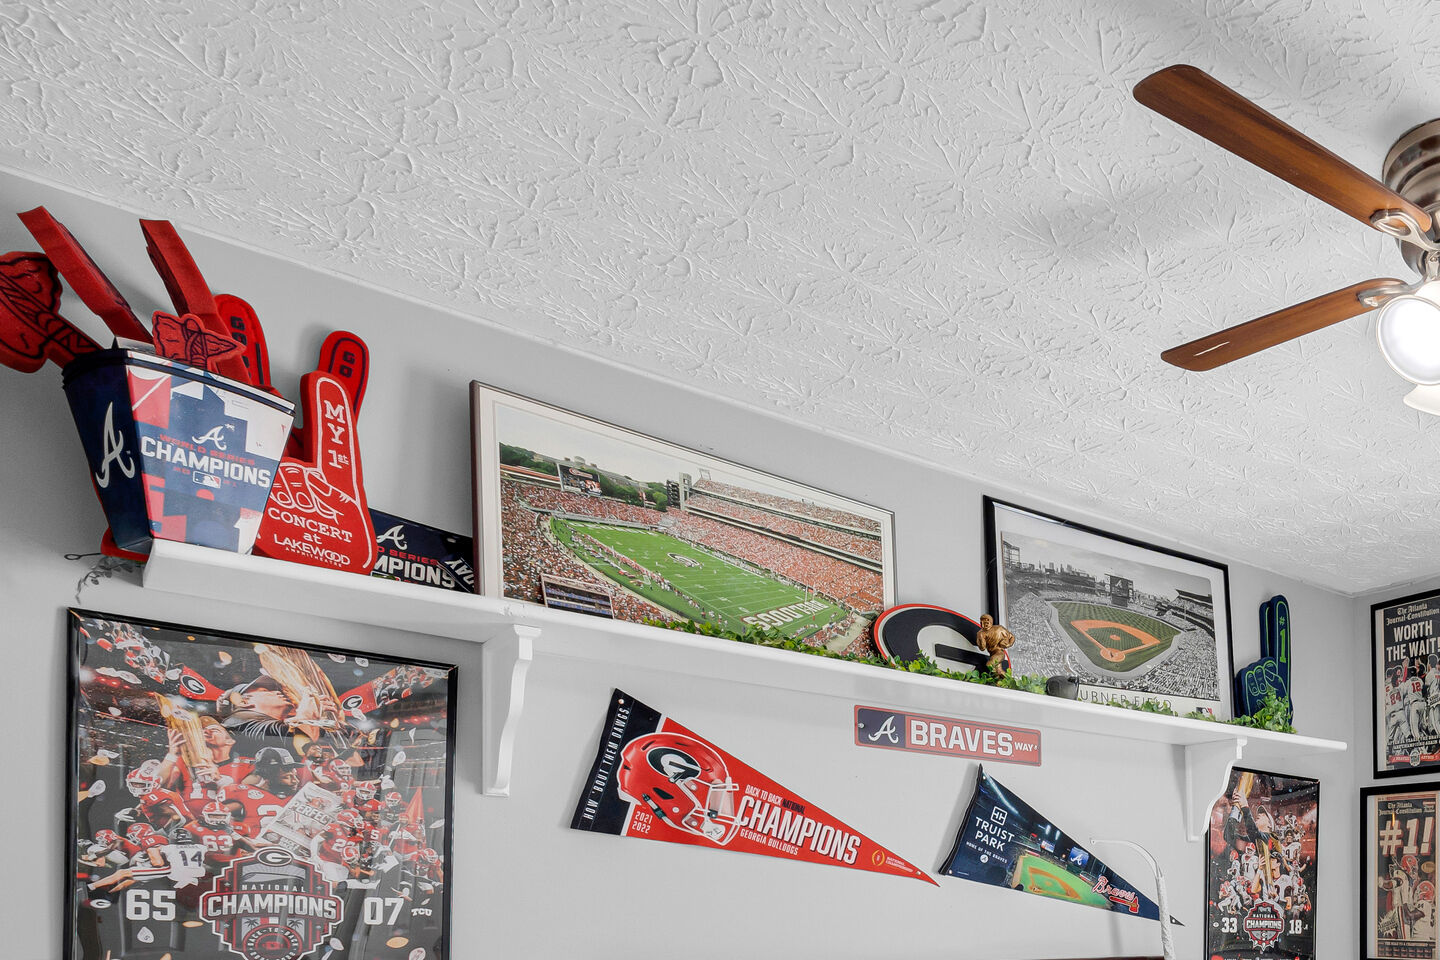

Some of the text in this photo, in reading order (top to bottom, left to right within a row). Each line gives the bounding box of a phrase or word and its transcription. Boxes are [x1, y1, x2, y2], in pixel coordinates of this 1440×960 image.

[141, 436, 271, 488] CHAMPIONS
[328, 449, 349, 469] 1st
[268, 507, 352, 543] CONCERT
[274, 534, 350, 566] LAKEWOOD
[303, 532, 322, 545] at
[394, 551, 438, 566] SERIES
[375, 555, 455, 588] MPIONS
[1393, 619, 1433, 643] WORTH
[1386, 636, 1440, 662] THE WAIT!
[1080, 689, 1127, 703] URNER
[910, 719, 1013, 756] BRAVES
[1014, 742, 1034, 752] WAY
[583, 799, 599, 820] HOW
[603, 741, 619, 765] THEM
[612, 707, 630, 739] DAWGS
[745, 784, 760, 798] BACK
[760, 789, 768, 800] TO
[768, 793, 782, 806] BACK
[632, 821, 651, 834] 2022
[635, 811, 653, 824] 2021
[975, 816, 1015, 842] TRUIST
[737, 795, 861, 865] CHAMPIONS
[740, 828, 799, 856] GEORGIA BULLDOGS
[975, 830, 1006, 852] PARK
[1379, 816, 1435, 857] #1!
[242, 883, 305, 893] NATIONAL
[126, 889, 176, 921] 65
[207, 894, 337, 919] CHAMPIONS
[364, 896, 404, 925] 07
[411, 907, 432, 917] TCU
[1221, 917, 1238, 933] 33
[1246, 920, 1282, 929] CHAMPIONS
[1288, 919, 1302, 934] 18
